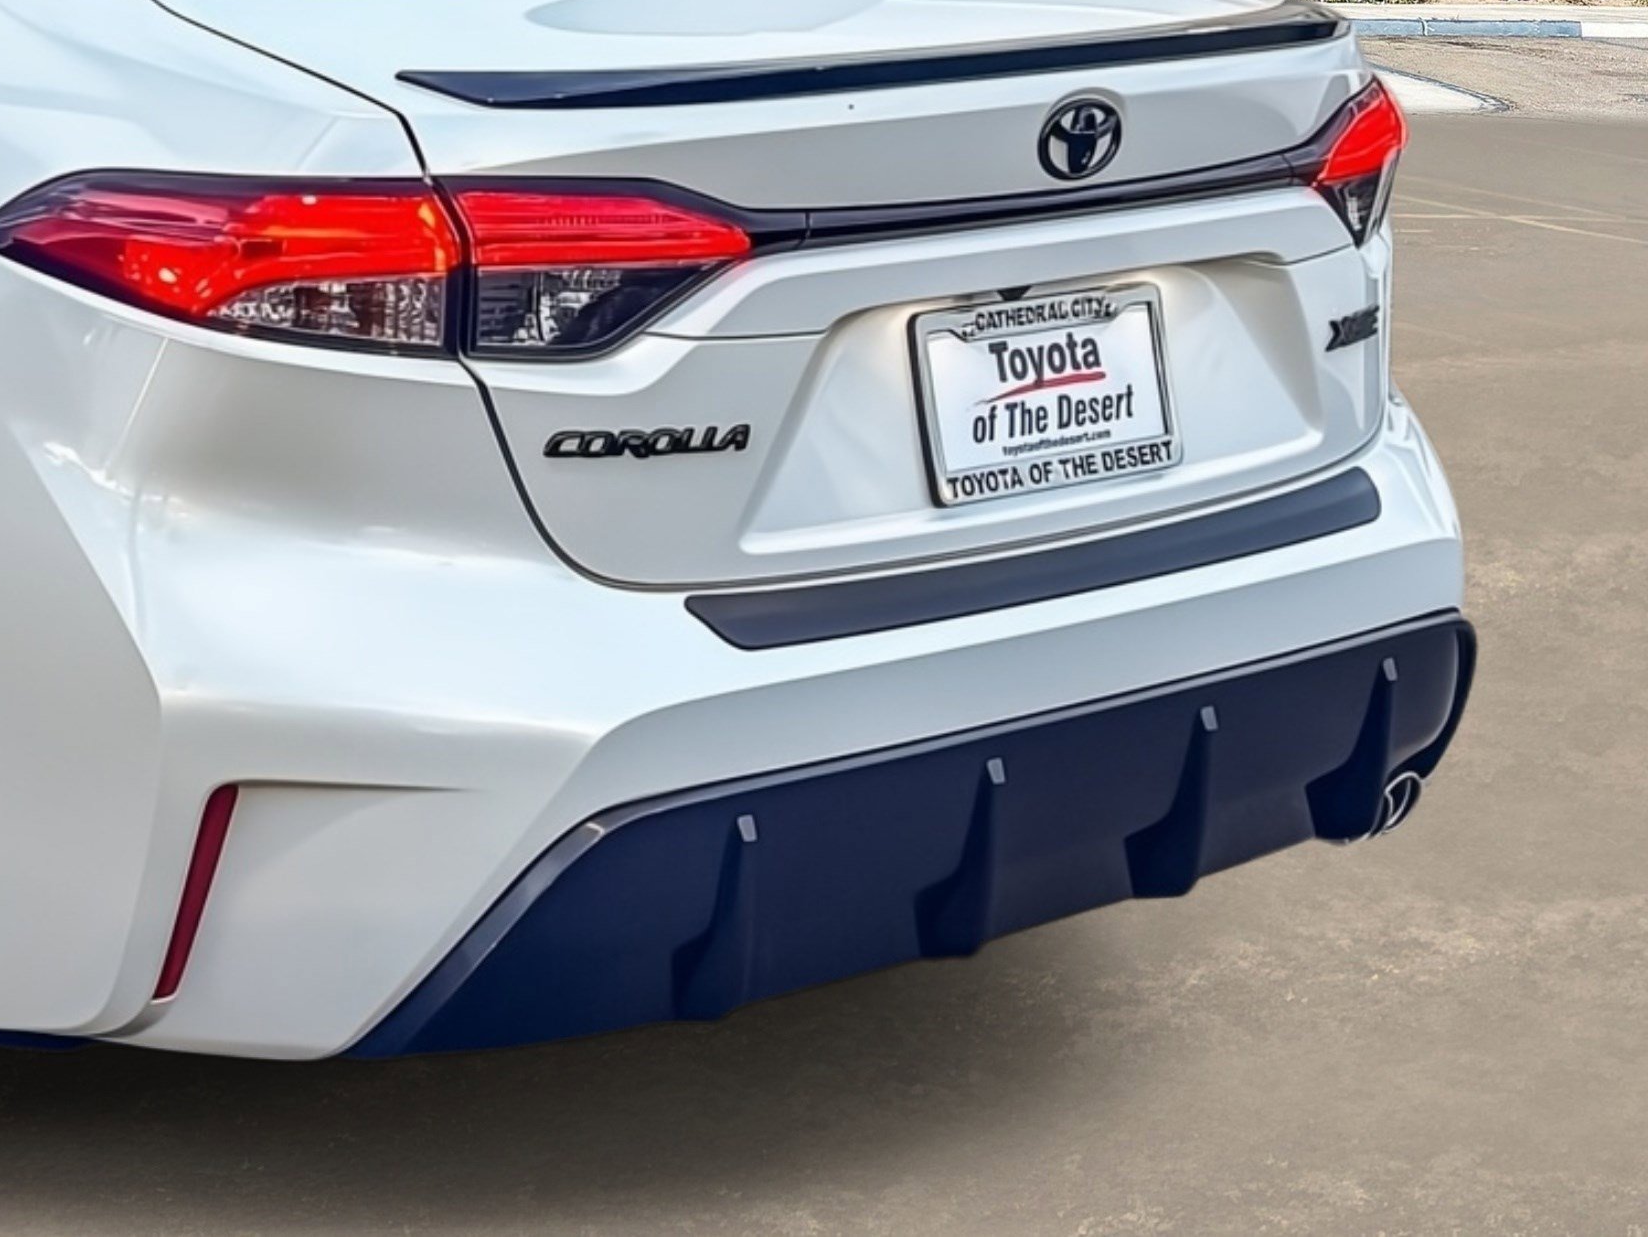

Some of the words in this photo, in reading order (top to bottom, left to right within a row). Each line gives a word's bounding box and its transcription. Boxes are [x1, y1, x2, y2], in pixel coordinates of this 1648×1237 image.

[974, 300, 1069, 331] CATHEDRAL
[1071, 296, 1106, 319] CITY
[988, 332, 1103, 386] Toyota
[542, 423, 751, 459] COROLLA
[972, 405, 997, 444] of
[1004, 400, 1049, 439] The
[1057, 384, 1134, 430] Desert
[946, 466, 1024, 499] TOYOTA
[1029, 461, 1053, 485] OF
[1058, 454, 1099, 479] THE
[1100, 439, 1173, 472] DESERT
